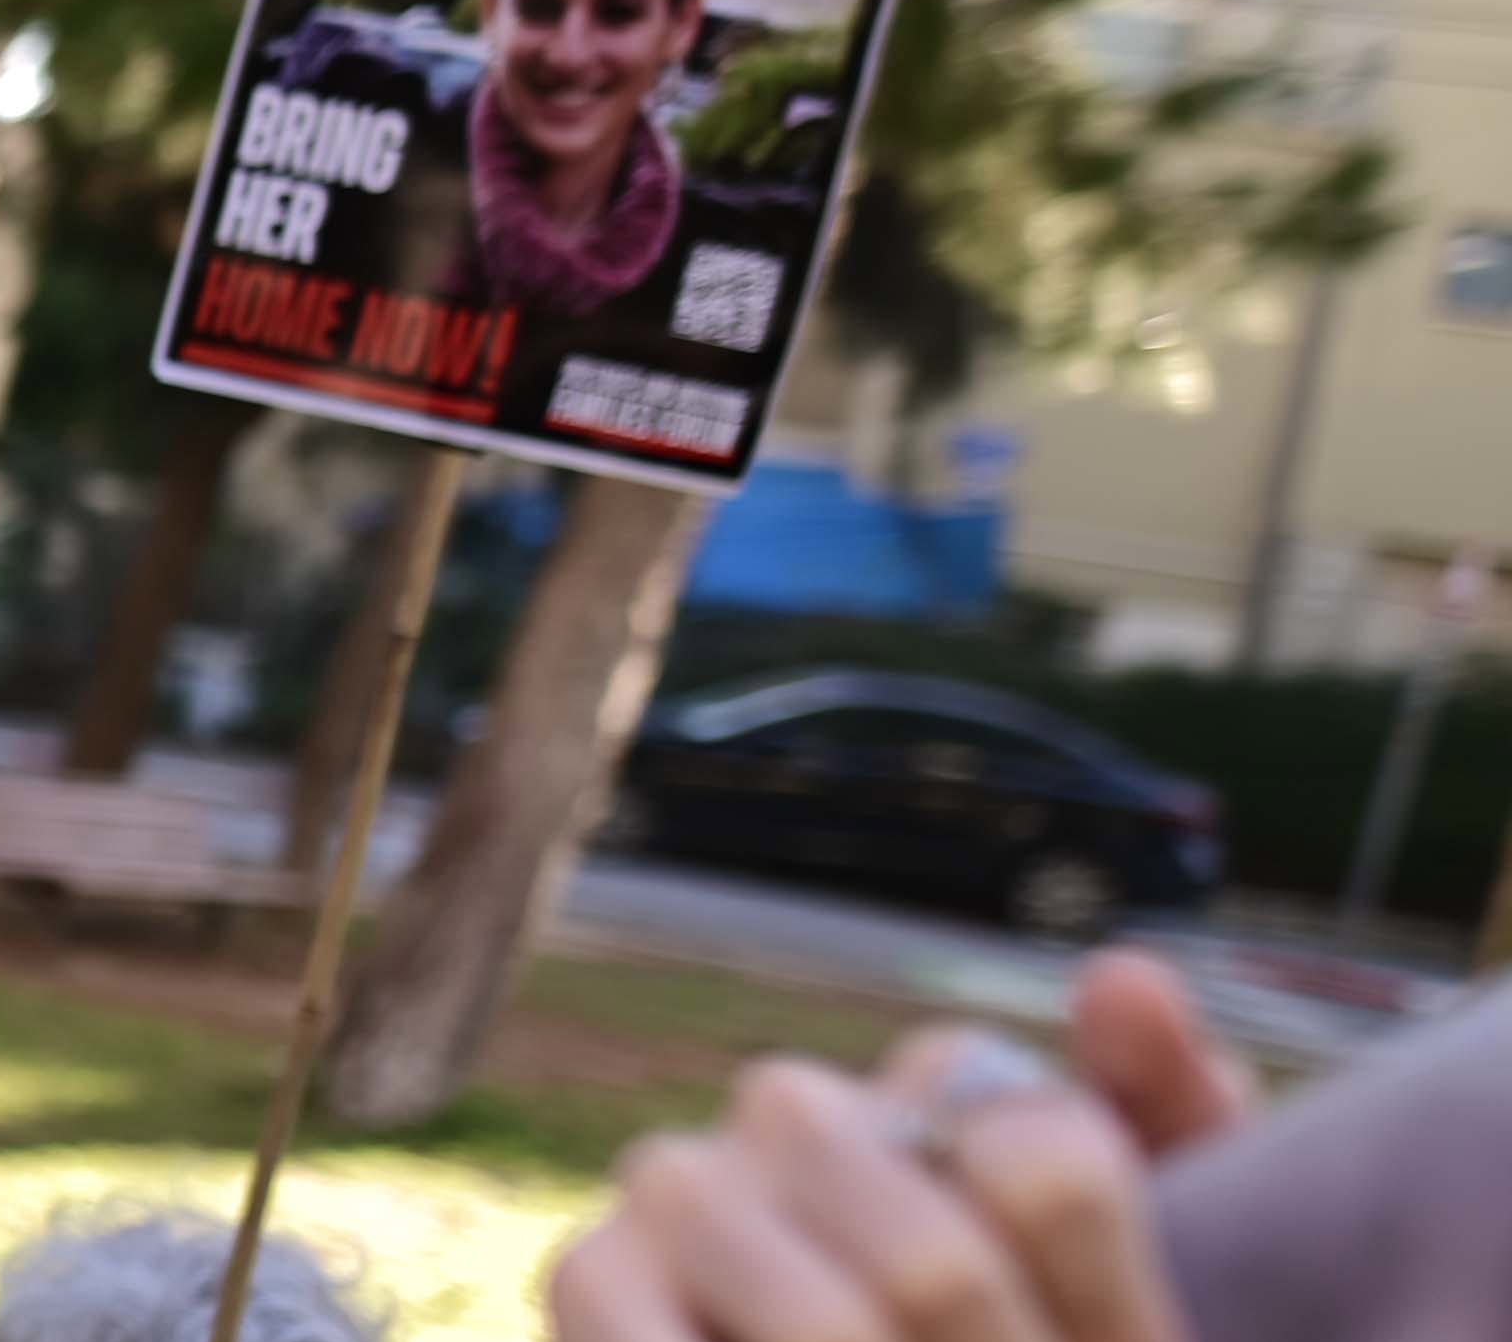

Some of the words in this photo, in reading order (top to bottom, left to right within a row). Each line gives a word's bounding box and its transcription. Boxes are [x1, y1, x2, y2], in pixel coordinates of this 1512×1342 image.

[237, 82, 409, 193] BRING
[215, 167, 329, 264] HER
[195, 254, 352, 359] HOME
[348, 287, 518, 392] NOW!
